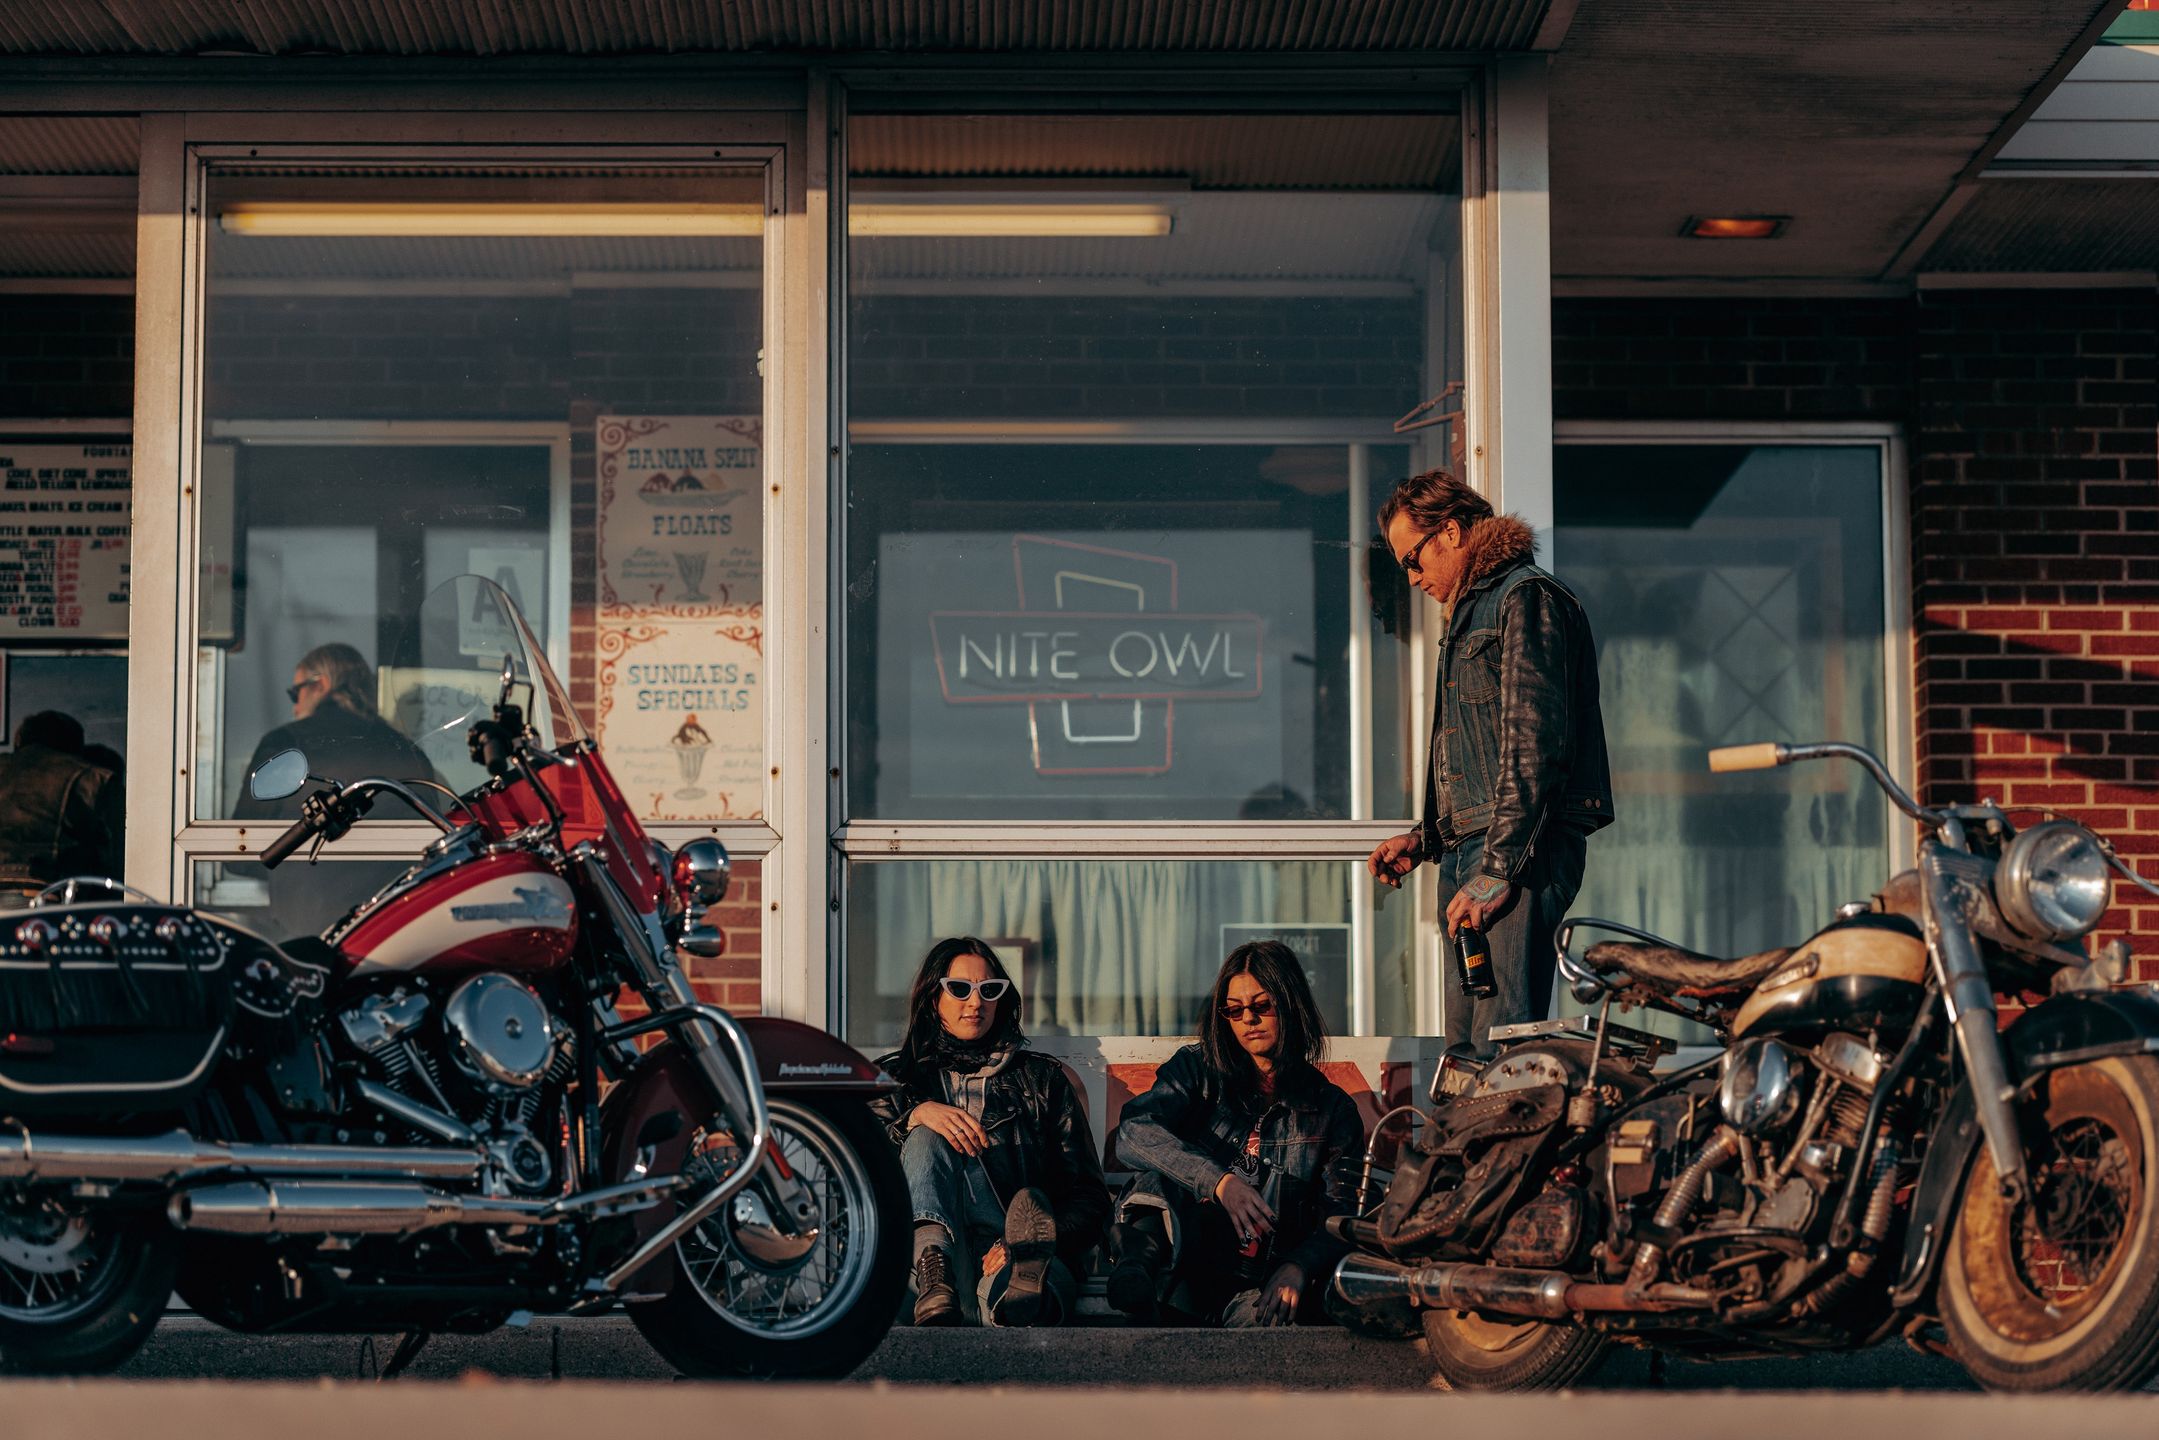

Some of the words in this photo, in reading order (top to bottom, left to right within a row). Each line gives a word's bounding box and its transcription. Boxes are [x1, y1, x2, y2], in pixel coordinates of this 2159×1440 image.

[627, 447, 707, 469] BANANA
[715, 447, 758, 469] SPLIT
[653, 515, 732, 535] FLOATS
[960, 632, 1079, 678] NITE
[1109, 631, 1245, 677] OWL
[628, 663, 738, 684] SUNDAES
[637, 689, 749, 710] SPECIALS
